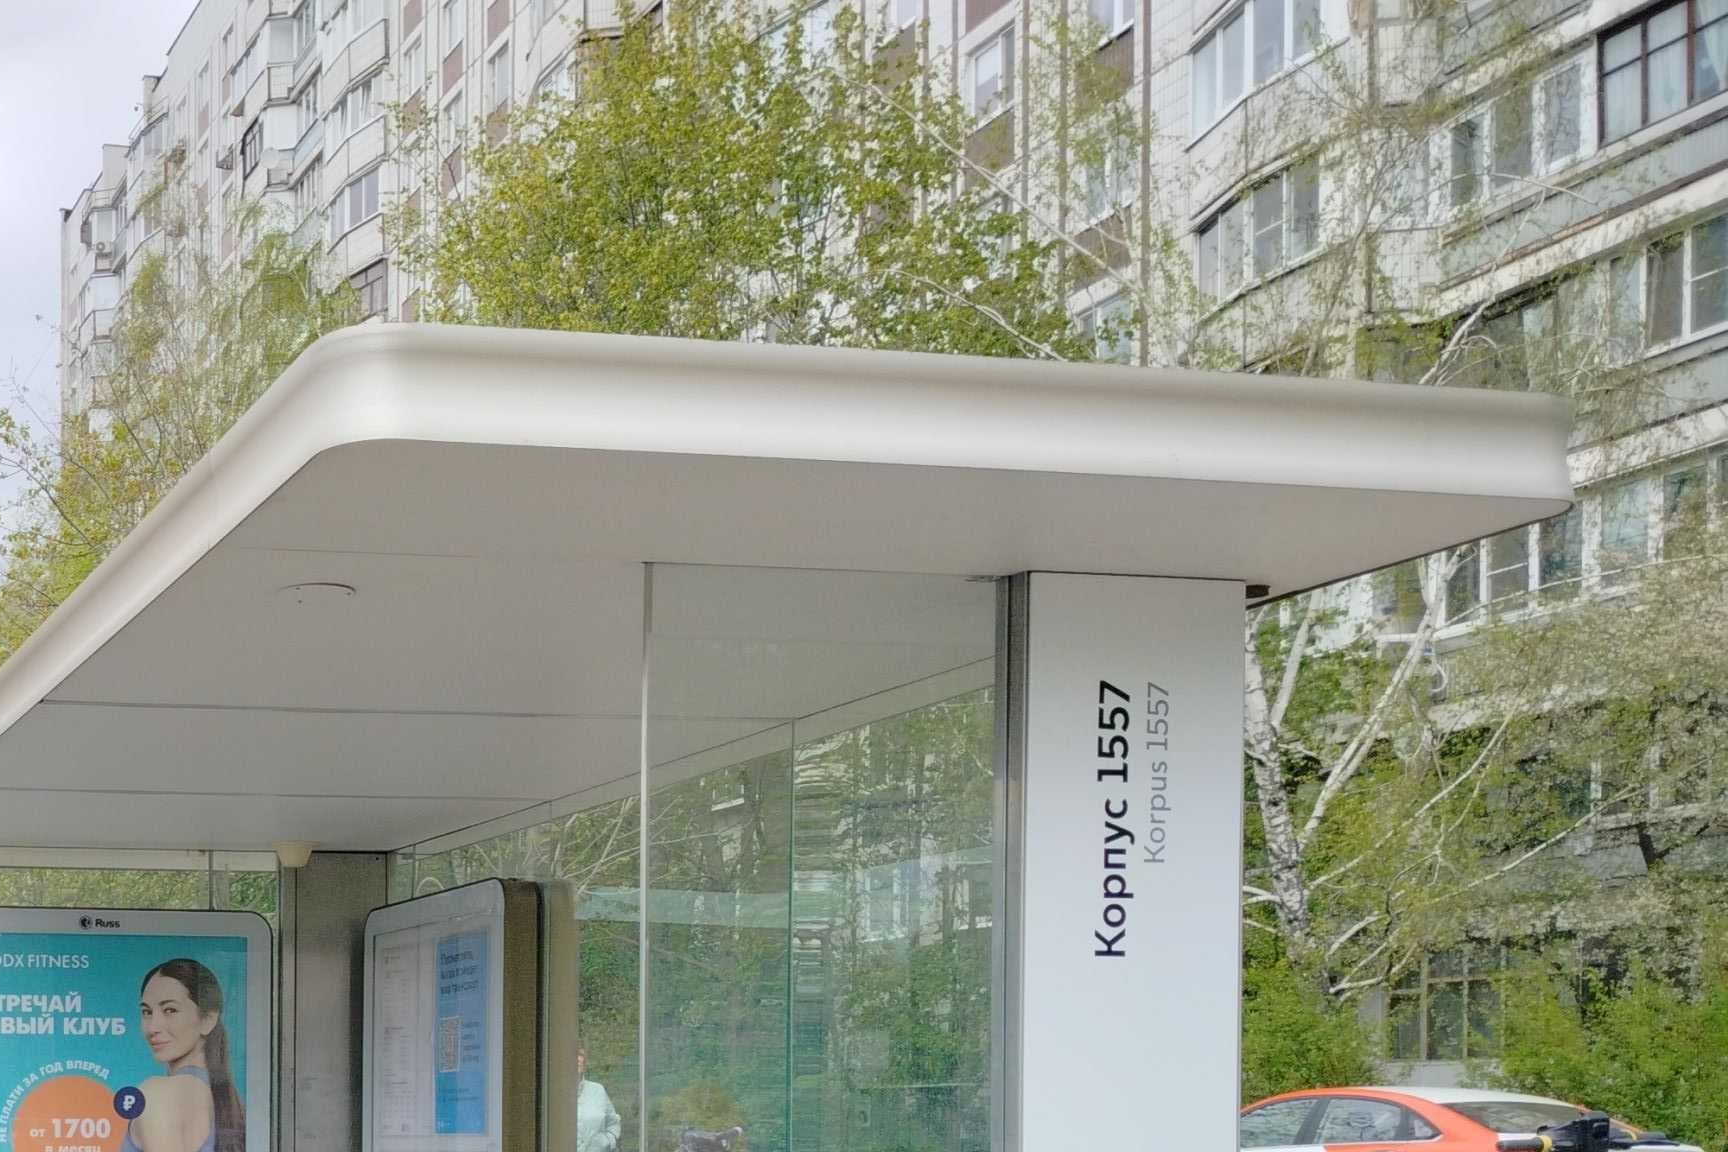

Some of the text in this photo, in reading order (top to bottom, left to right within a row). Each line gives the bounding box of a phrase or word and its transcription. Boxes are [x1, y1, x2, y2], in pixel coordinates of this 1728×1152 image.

[1143, 682, 1172, 863] Korpus 1557
[1094, 680, 1135, 957] Корпус 1557
[95, 919, 120, 928] Russ
[28, 954, 89, 968] FITNESS
[63, 1017, 126, 1035] КЛУБ
[0, 1085, 24, 1124] ПЛАТИ
[22, 1073, 39, 1087] ЗА
[40, 1062, 64, 1076] ГОД
[29, 1118, 111, 1138] от 1700
